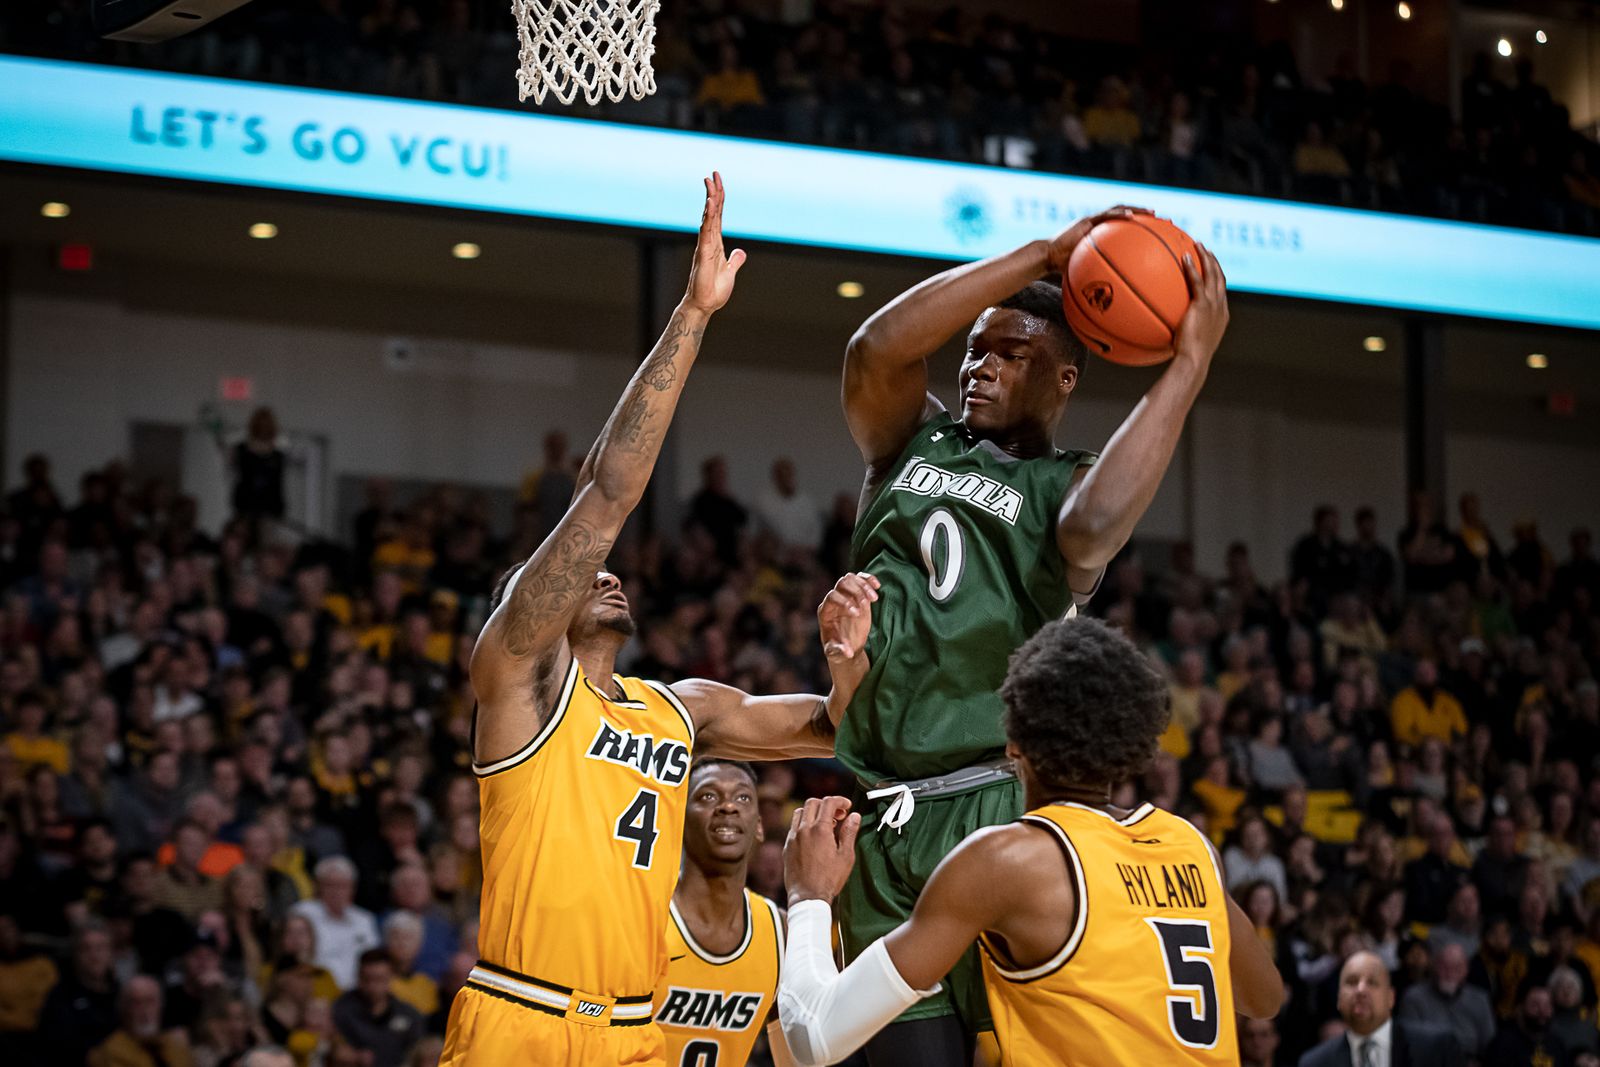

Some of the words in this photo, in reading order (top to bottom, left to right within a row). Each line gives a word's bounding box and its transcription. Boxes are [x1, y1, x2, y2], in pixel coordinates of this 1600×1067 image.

[129, 104, 268, 156] LET'S
[292, 122, 366, 165] GO
[391, 134, 510, 182] VCU!
[891, 455, 1024, 526] LOYOLA
[919, 507, 966, 603] 0
[586, 718, 690, 786] RAMS
[614, 788, 660, 871] 4
[1116, 862, 1207, 909] HYLAND
[576, 1000, 607, 1018] VCU
[655, 987, 764, 1032] RAMS
[1144, 917, 1219, 1049] 5
